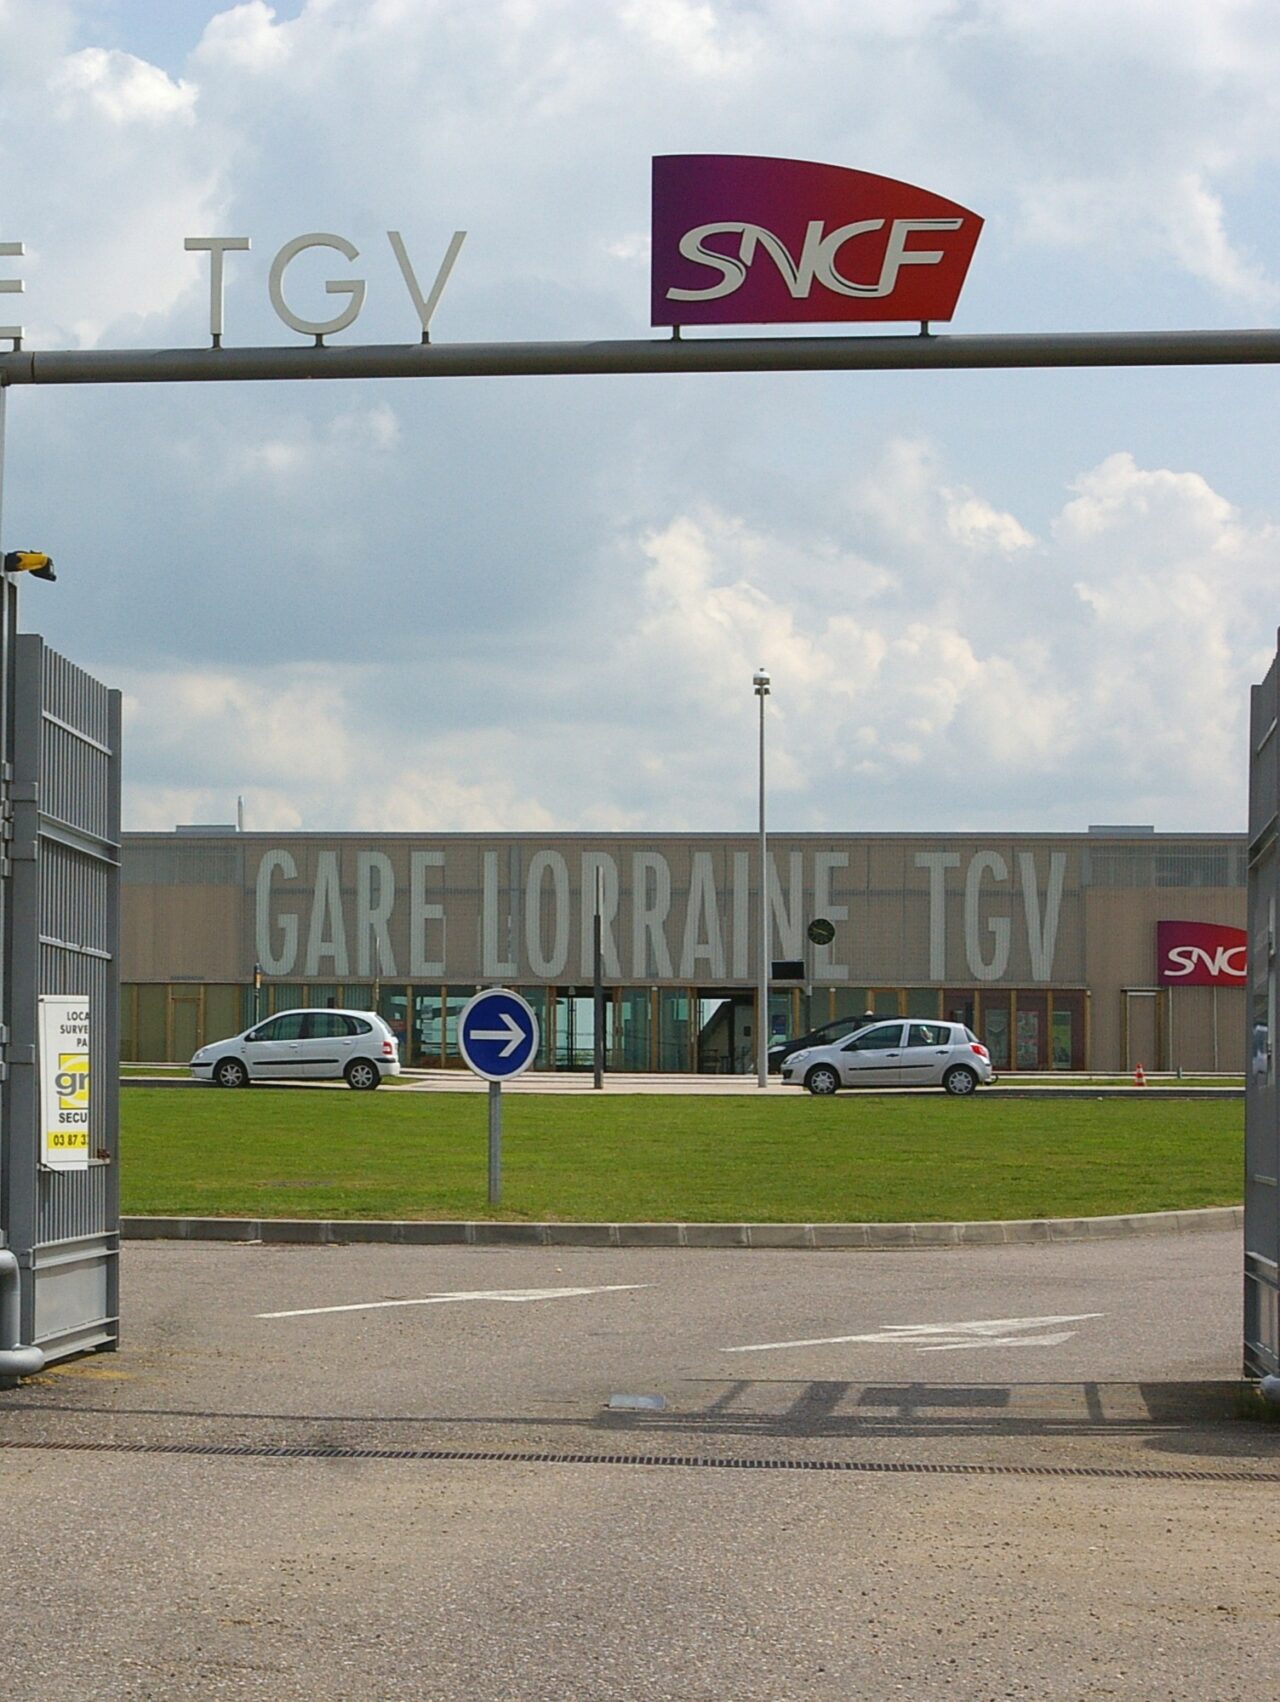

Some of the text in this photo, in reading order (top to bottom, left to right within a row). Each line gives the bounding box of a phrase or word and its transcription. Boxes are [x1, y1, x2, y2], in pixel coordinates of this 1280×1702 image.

[183, 231, 468, 336] TGV
[666, 217, 965, 302] SNCF
[255, 848, 1067, 982] GARE LORRAINE TGV
[1163, 946, 1248, 976] SNC
[53, 1134, 65, 1146] 03
[67, 1134, 78, 1146] 87
[58, 1112, 88, 1123] SECU
